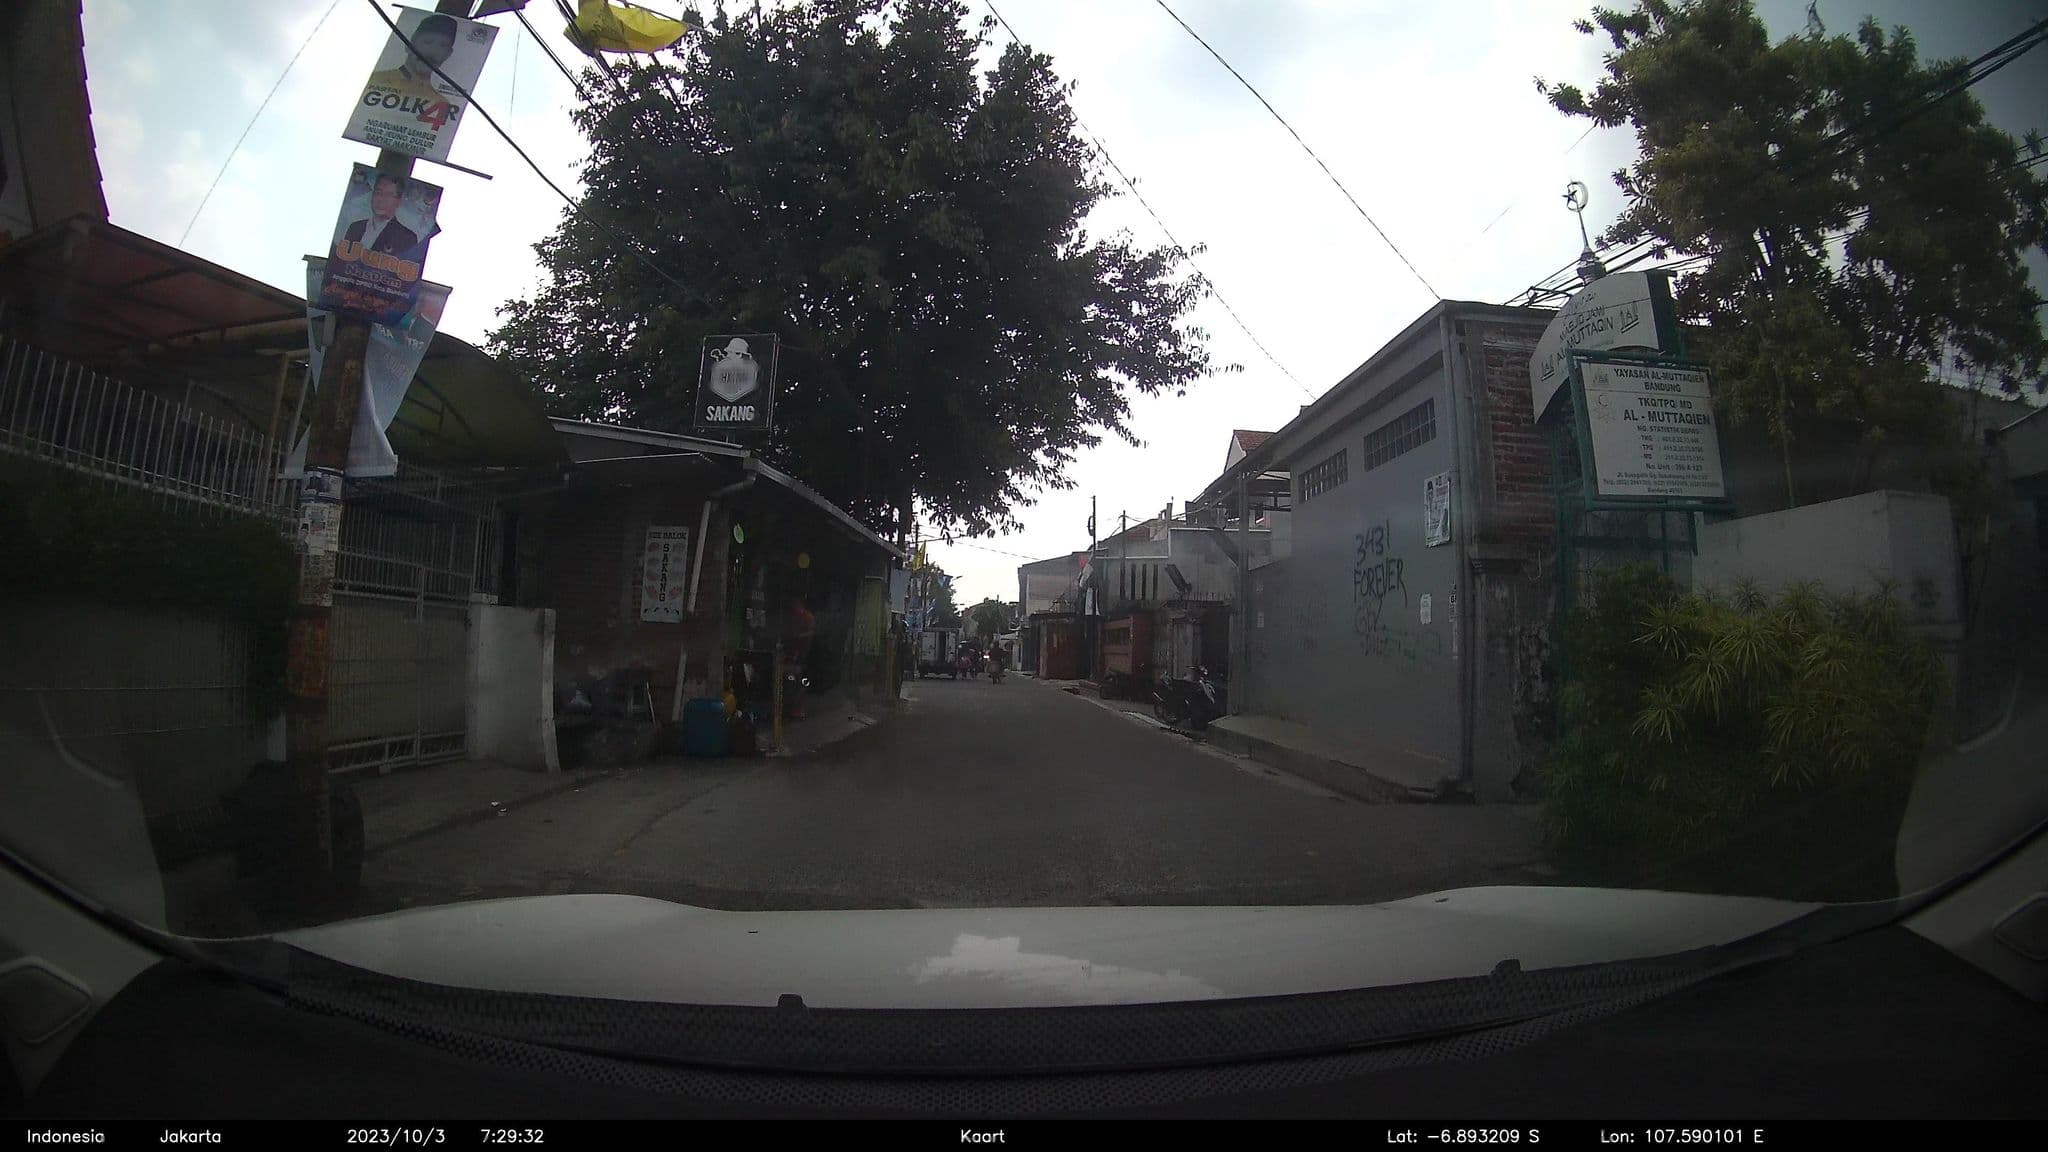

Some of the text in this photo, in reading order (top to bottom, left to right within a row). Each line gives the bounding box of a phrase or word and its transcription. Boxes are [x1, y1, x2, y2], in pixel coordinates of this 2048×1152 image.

[1614, 368, 1705, 383] YAYASAN AL-MUTTAQIEN
[1644, 381, 1681, 392] BANDUNG
[706, 405, 755, 422] SAKANG
[1624, 409, 1639, 422] AL
[1648, 411, 1711, 425] MUTTAQIEN
[1353, 557, 1408, 609] FOREVER
